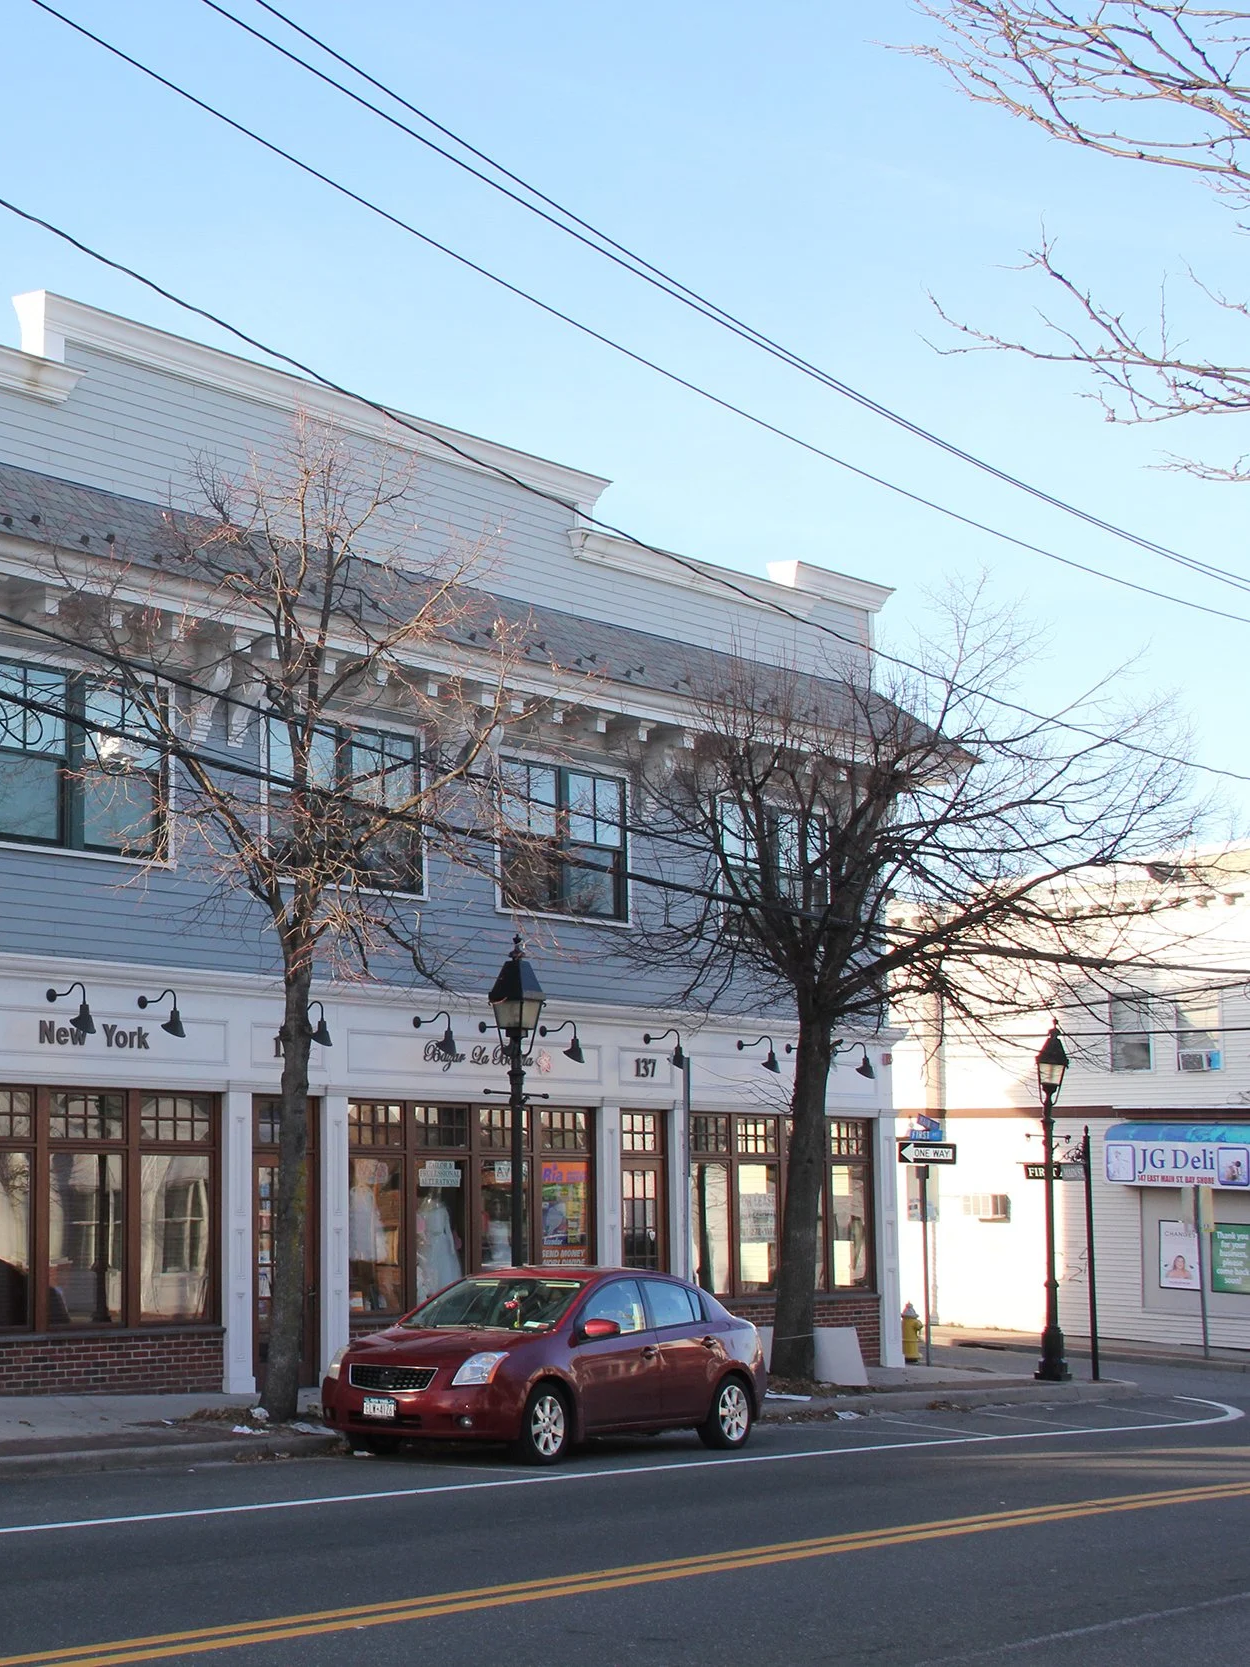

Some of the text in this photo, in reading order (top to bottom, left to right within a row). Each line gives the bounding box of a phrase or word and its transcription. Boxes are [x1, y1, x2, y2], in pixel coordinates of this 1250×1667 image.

[39, 1019, 150, 1050] New York
[470, 1045, 490, 1066] La
[634, 1057, 657, 1078] 137
[911, 1130, 930, 1140] FIRST
[914, 1149, 950, 1158] ONE WAY
[1138, 1148, 1215, 1174] JG Deli
[543, 1161, 563, 1181] Ria
[1027, 1167, 1058, 1177] FIRT
[1196, 1176, 1215, 1184] SHORE
[1216, 1231, 1249, 1241] Thank you
[1220, 1240, 1247, 1251] for your
[542, 1249, 585, 1257] SEND MONEY
[1222, 1259, 1244, 1267] please
